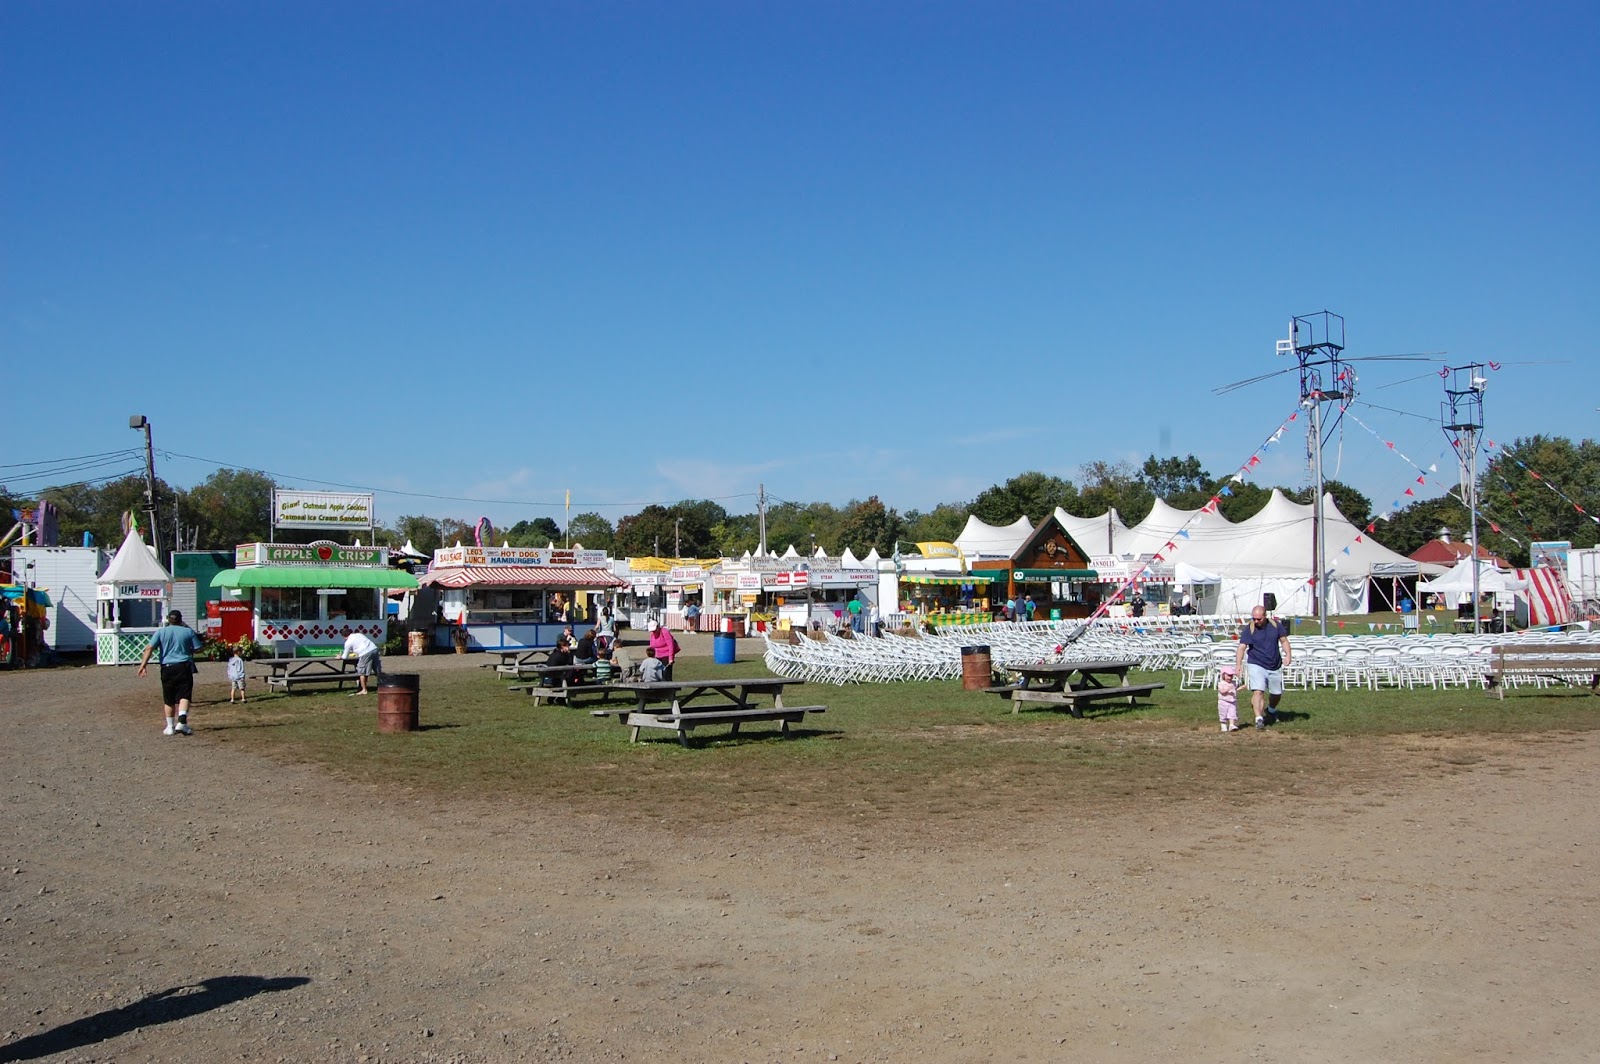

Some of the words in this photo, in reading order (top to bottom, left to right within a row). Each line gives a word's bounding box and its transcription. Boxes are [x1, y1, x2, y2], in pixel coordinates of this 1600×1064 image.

[282, 500, 300, 510] Giant
[274, 549, 312, 559] APPLE
[338, 551, 374, 560] CRISP
[440, 552, 462, 562] SAUSAGE
[121, 584, 138, 594] LIME
[140, 588, 160, 596] RICKEY
